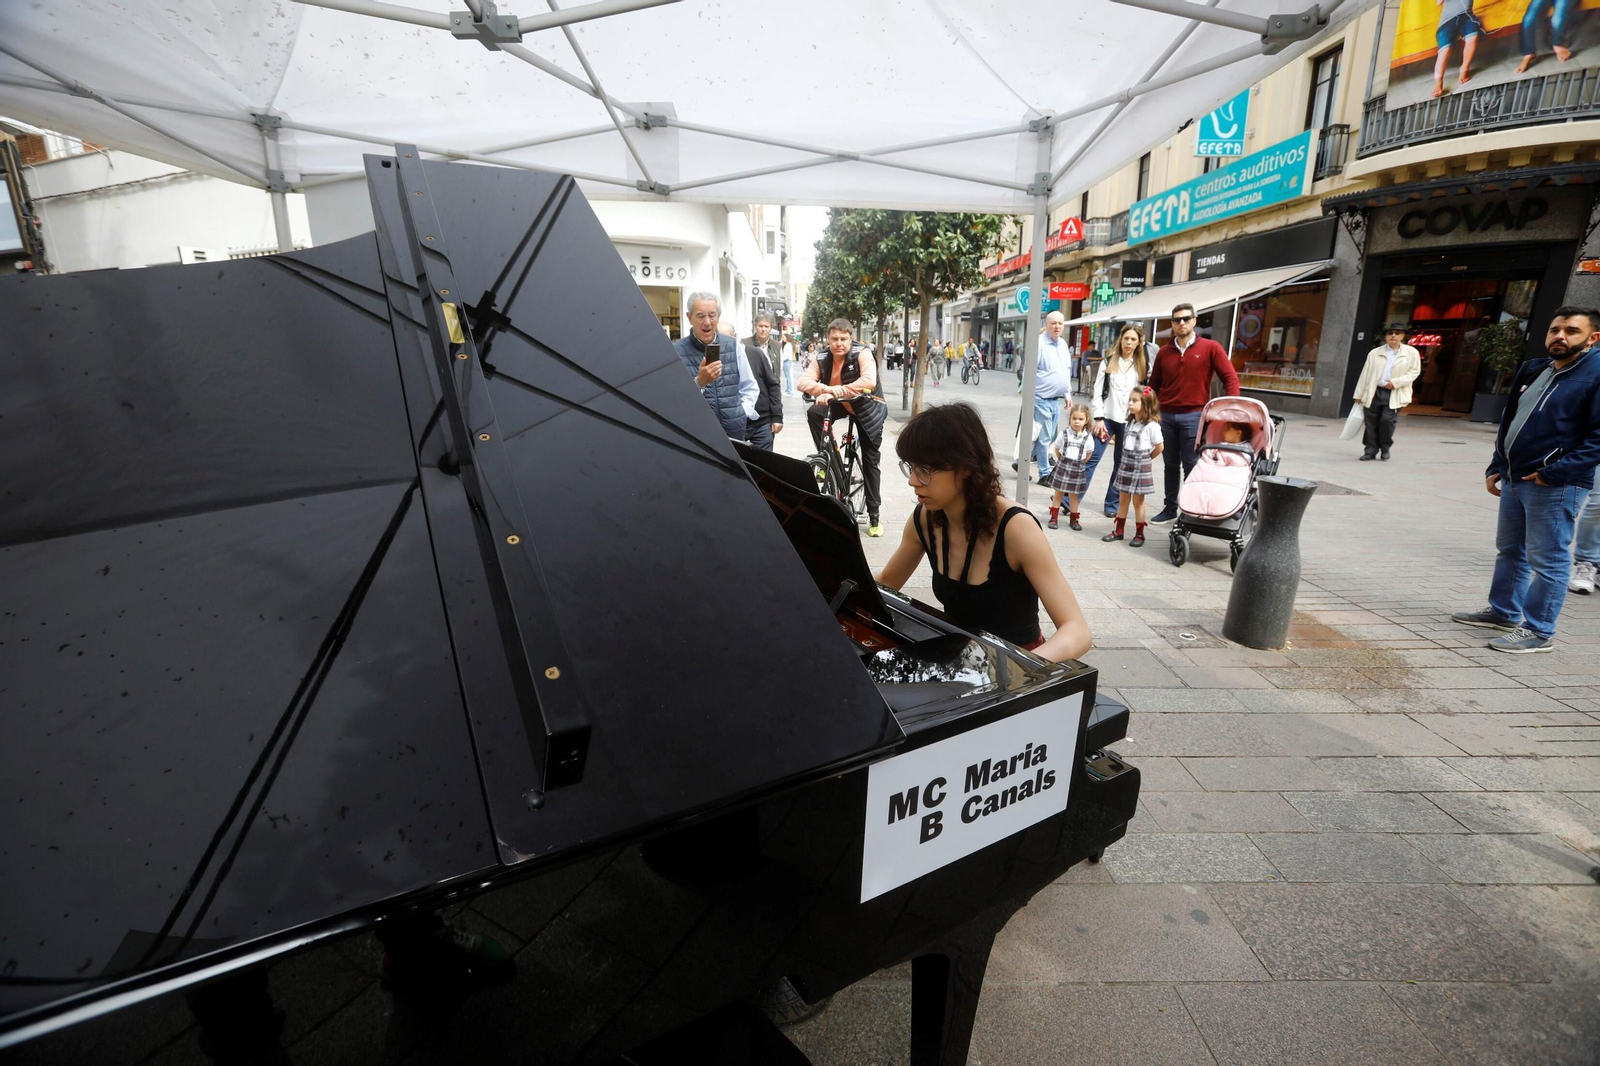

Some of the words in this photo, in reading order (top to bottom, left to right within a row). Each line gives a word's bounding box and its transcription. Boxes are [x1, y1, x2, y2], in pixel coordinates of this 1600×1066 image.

[1199, 142, 1242, 156] EFETA
[1194, 171, 1237, 199] centros
[1239, 144, 1306, 183] auditivos
[1130, 190, 1191, 239] EFETA
[1192, 200, 1227, 222] AUDIOLOGÍA
[1227, 190, 1263, 211] AVANZADA
[1397, 197, 1549, 239] COVAP
[1197, 253, 1226, 268] TIENDAS
[1280, 367, 1312, 381] TIENDA
[964, 742, 1048, 794] Maria
[919, 810, 944, 845] B
[960, 767, 1057, 825] Canals
